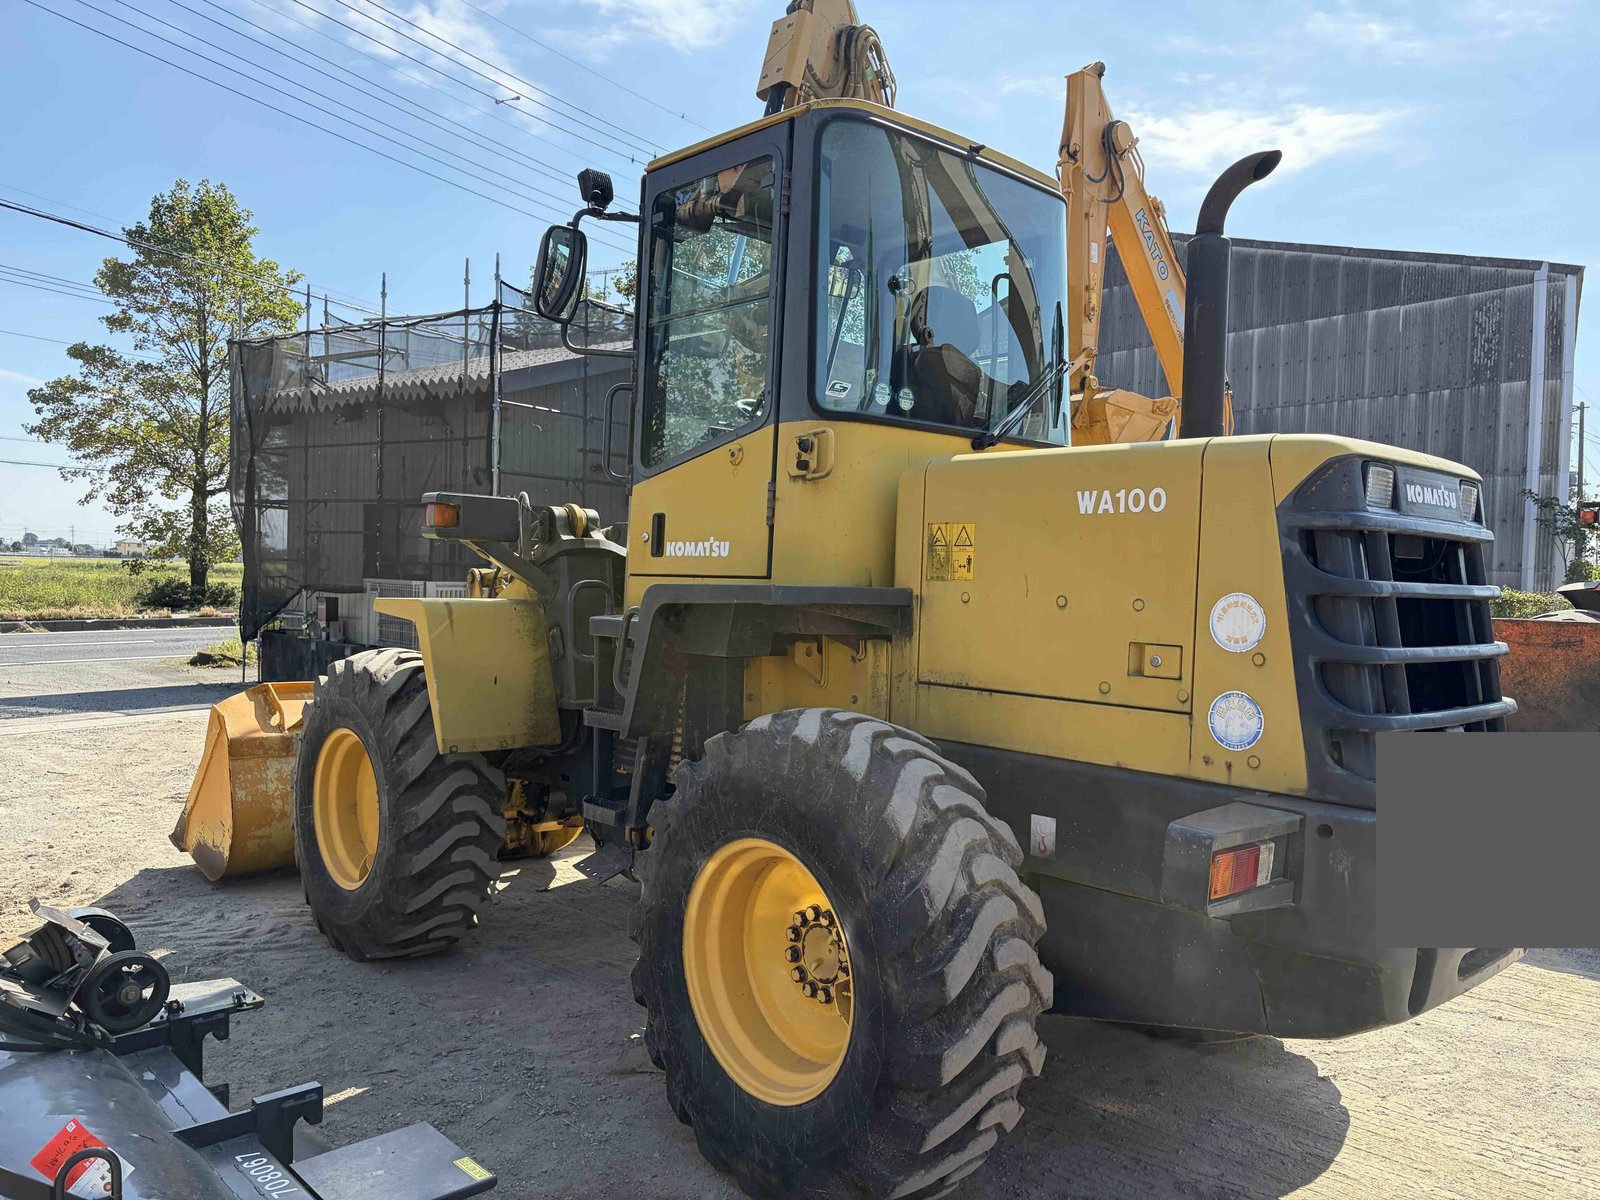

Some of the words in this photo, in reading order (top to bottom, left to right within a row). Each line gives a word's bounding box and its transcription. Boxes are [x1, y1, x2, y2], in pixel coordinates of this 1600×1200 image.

[1135, 207, 1169, 281] KATO
[1076, 487, 1167, 514] WA100
[1406, 484, 1457, 509] KOMATSU
[666, 537, 730, 557] KOMATSU
[234, 1151, 298, 1199] 708067
